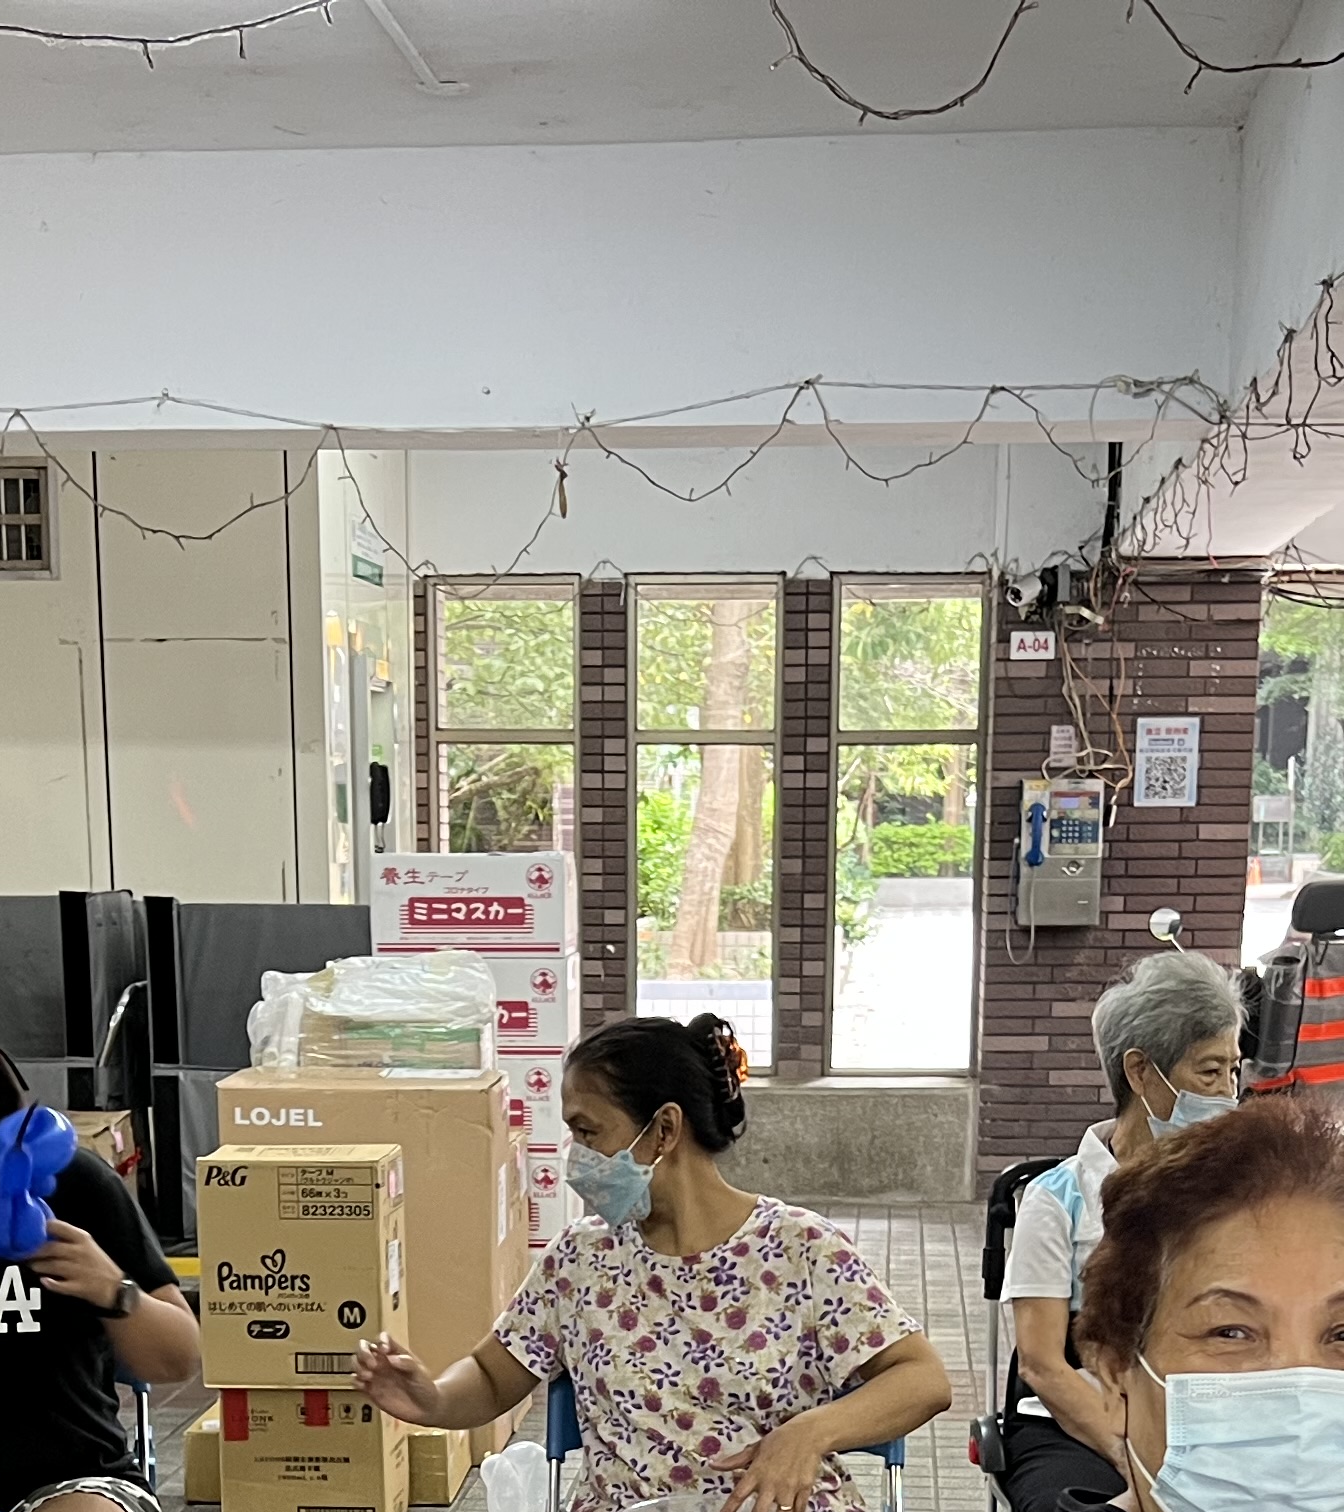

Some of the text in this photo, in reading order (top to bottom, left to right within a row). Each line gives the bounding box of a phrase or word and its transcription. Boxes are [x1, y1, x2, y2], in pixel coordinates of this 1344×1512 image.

[1016, 637, 1049, 652] A-04
[379, 867, 469, 885] 養生テープ
[412, 901, 524, 921] ミニマスカー
[234, 1107, 323, 1127] LOJEL
[204, 1165, 248, 1187] P&G
[302, 1204, 371, 1217] 82323305
[217, 1261, 311, 1296] Pampers
[343, 1307, 361, 1324] M
